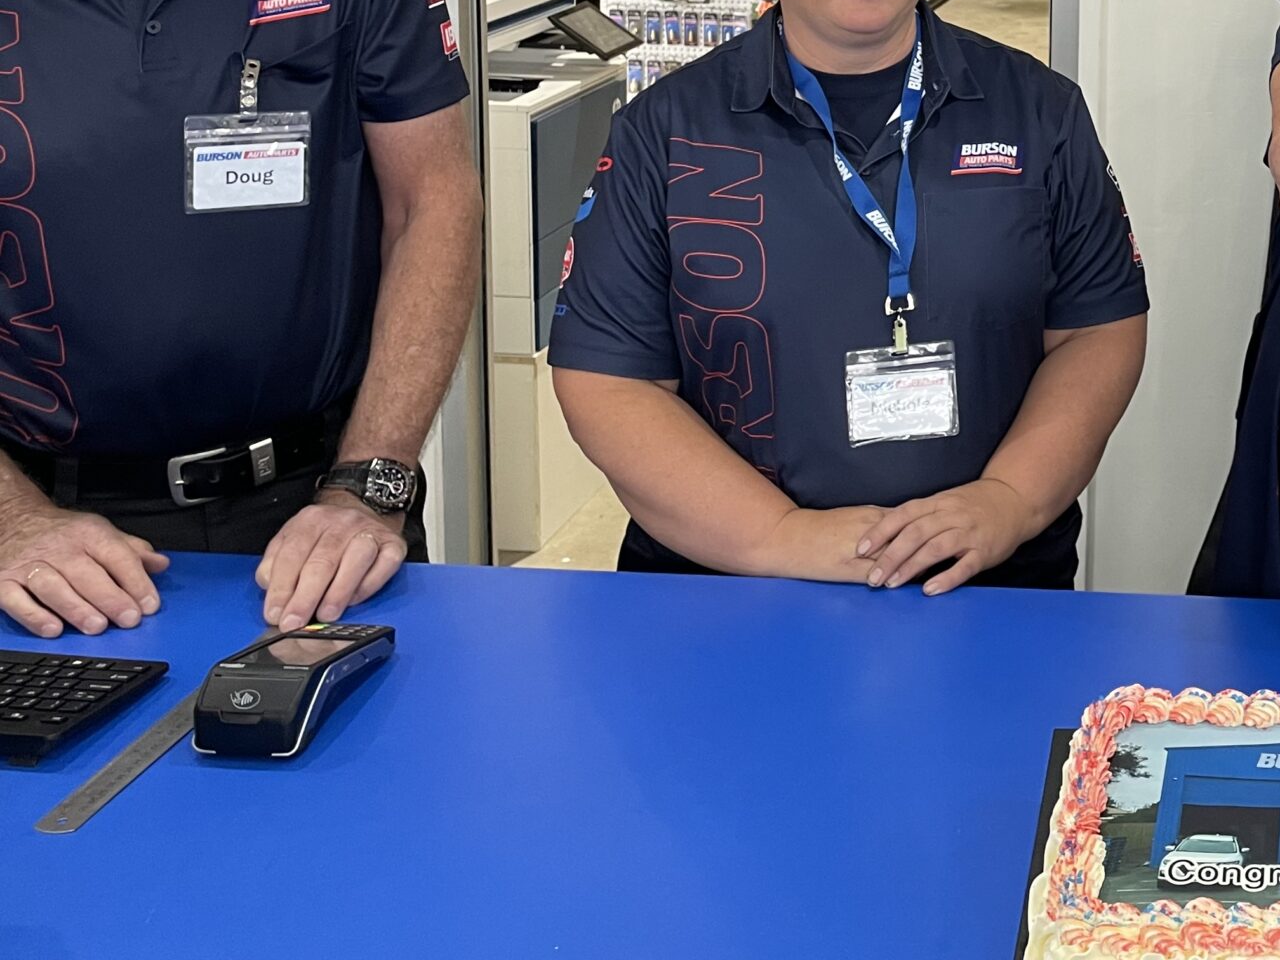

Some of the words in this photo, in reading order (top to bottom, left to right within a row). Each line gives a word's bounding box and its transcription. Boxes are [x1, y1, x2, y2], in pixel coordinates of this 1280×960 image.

[961, 141, 1018, 157] BURSON
[196, 151, 243, 162] BURSON
[964, 156, 987, 164] AUTO
[988, 155, 1013, 164] PARTS
[226, 170, 274, 185] Doug
